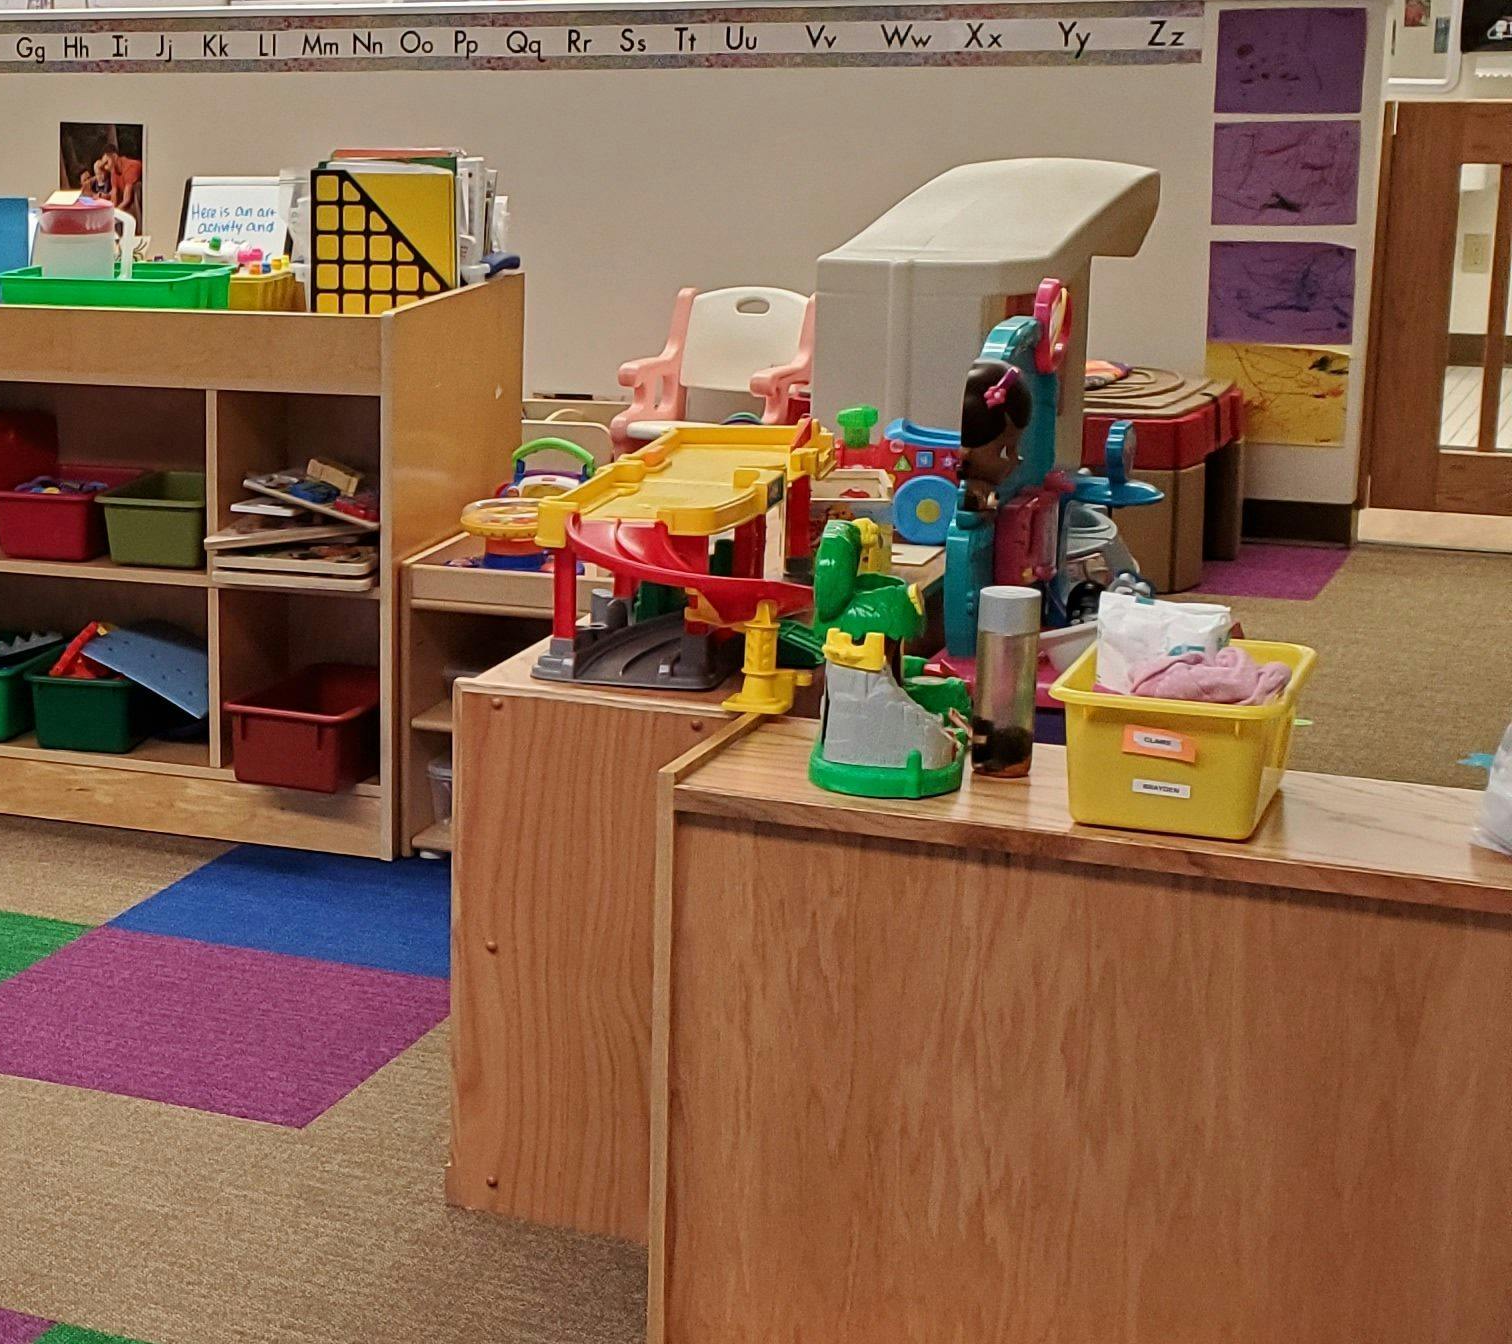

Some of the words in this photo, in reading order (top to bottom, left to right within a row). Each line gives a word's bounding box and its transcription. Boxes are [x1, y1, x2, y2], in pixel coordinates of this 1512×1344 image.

[17, 36, 46, 63] Gg
[63, 35, 90, 59] Hh
[112, 34, 128, 58] Ii
[155, 34, 174, 62] Jj
[203, 33, 229, 57] Kk
[259, 33, 277, 57] Ll
[301, 33, 339, 56] Mm
[352, 31, 383, 55] Nn
[399, 30, 434, 54] Oo
[453, 31, 479, 58] Pp
[505, 30, 544, 61] Qq
[567, 29, 593, 53] Rr
[619, 28, 647, 53] Ss
[674, 27, 697, 52] Tt
[725, 25, 758, 51] Uu
[805, 24, 837, 49] Vv
[880, 23, 932, 48] Ww
[964, 22, 1003, 49] Xx
[1057, 21, 1091, 59] Yy
[1147, 19, 1186, 47] Zz
[191, 203, 217, 220] Here
[220, 206, 230, 218] is
[235, 206, 253, 218] an
[257, 206, 277, 218] art
[197, 220, 243, 238] activity
[246, 221, 275, 234] and
[1142, 783, 1180, 794] BRAYDEN
